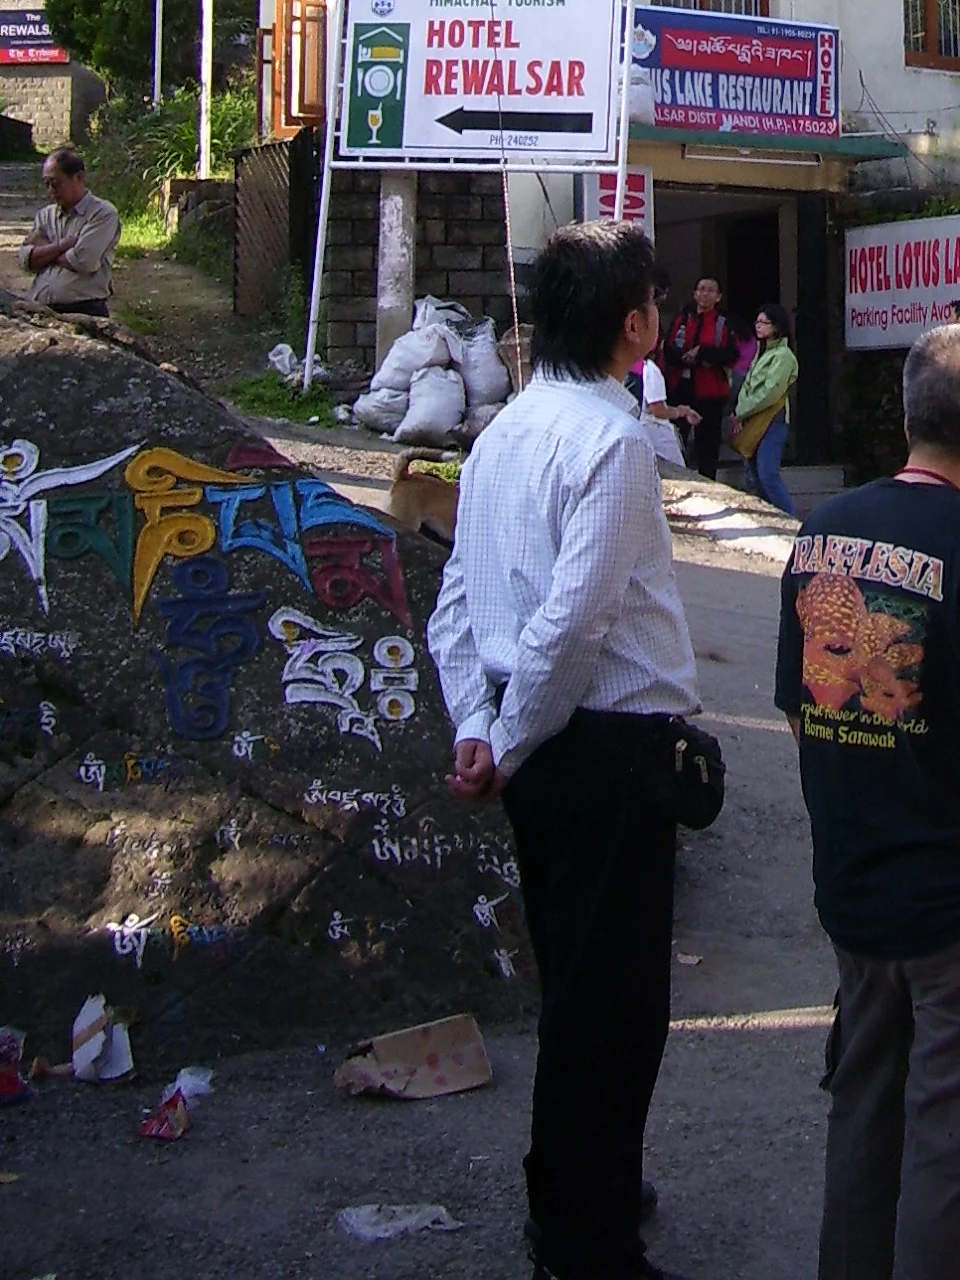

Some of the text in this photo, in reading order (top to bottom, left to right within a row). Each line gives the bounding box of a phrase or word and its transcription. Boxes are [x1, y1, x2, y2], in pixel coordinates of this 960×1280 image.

[0, 24, 52, 36] REWALS
[25, 13, 41, 21] The
[427, 20, 520, 48] HOTEL
[424, 59, 585, 97] REWALSAR
[819, 32, 833, 115] HOTEL
[651, 69, 813, 116] US LAKE RESTAURANT
[849, 244, 891, 294] HOTEL
[894, 238, 940, 290] LOTUS
[851, 304, 888, 332] Parking
[891, 301, 929, 327] Facility
[791, 535, 944, 602] RAFFLESIA
[838, 725, 896, 749] Sarawak
